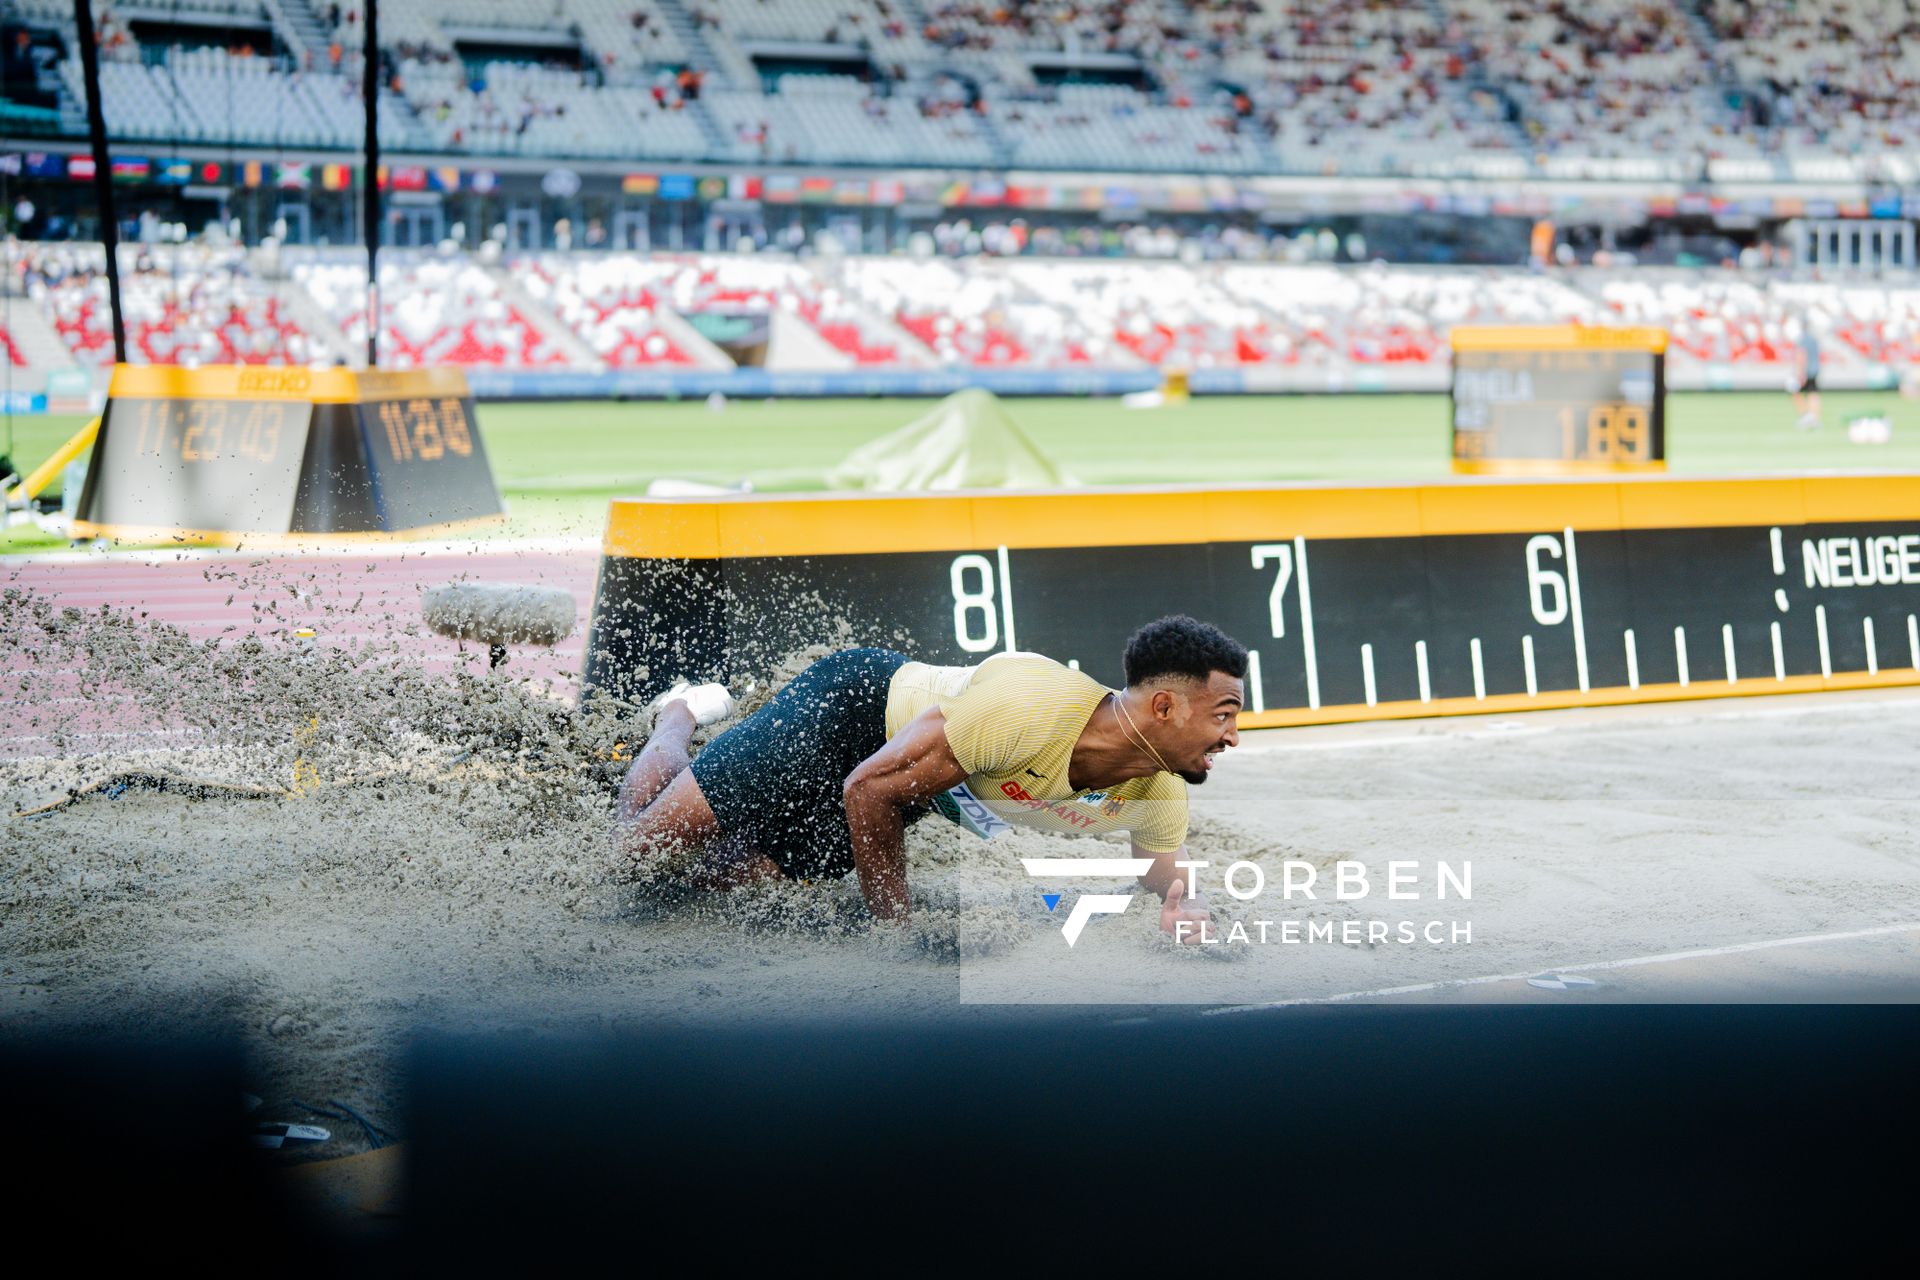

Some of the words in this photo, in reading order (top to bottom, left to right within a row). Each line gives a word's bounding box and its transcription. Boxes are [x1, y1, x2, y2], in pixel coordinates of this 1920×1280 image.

[136, 401, 286, 463] 11:23:43
[1251, 544, 1293, 638] 7
[1526, 535, 1568, 625] 6
[1802, 535, 1920, 589] NEUGE
[950, 554, 998, 653] 8
[951, 785, 1006, 832] TDK
